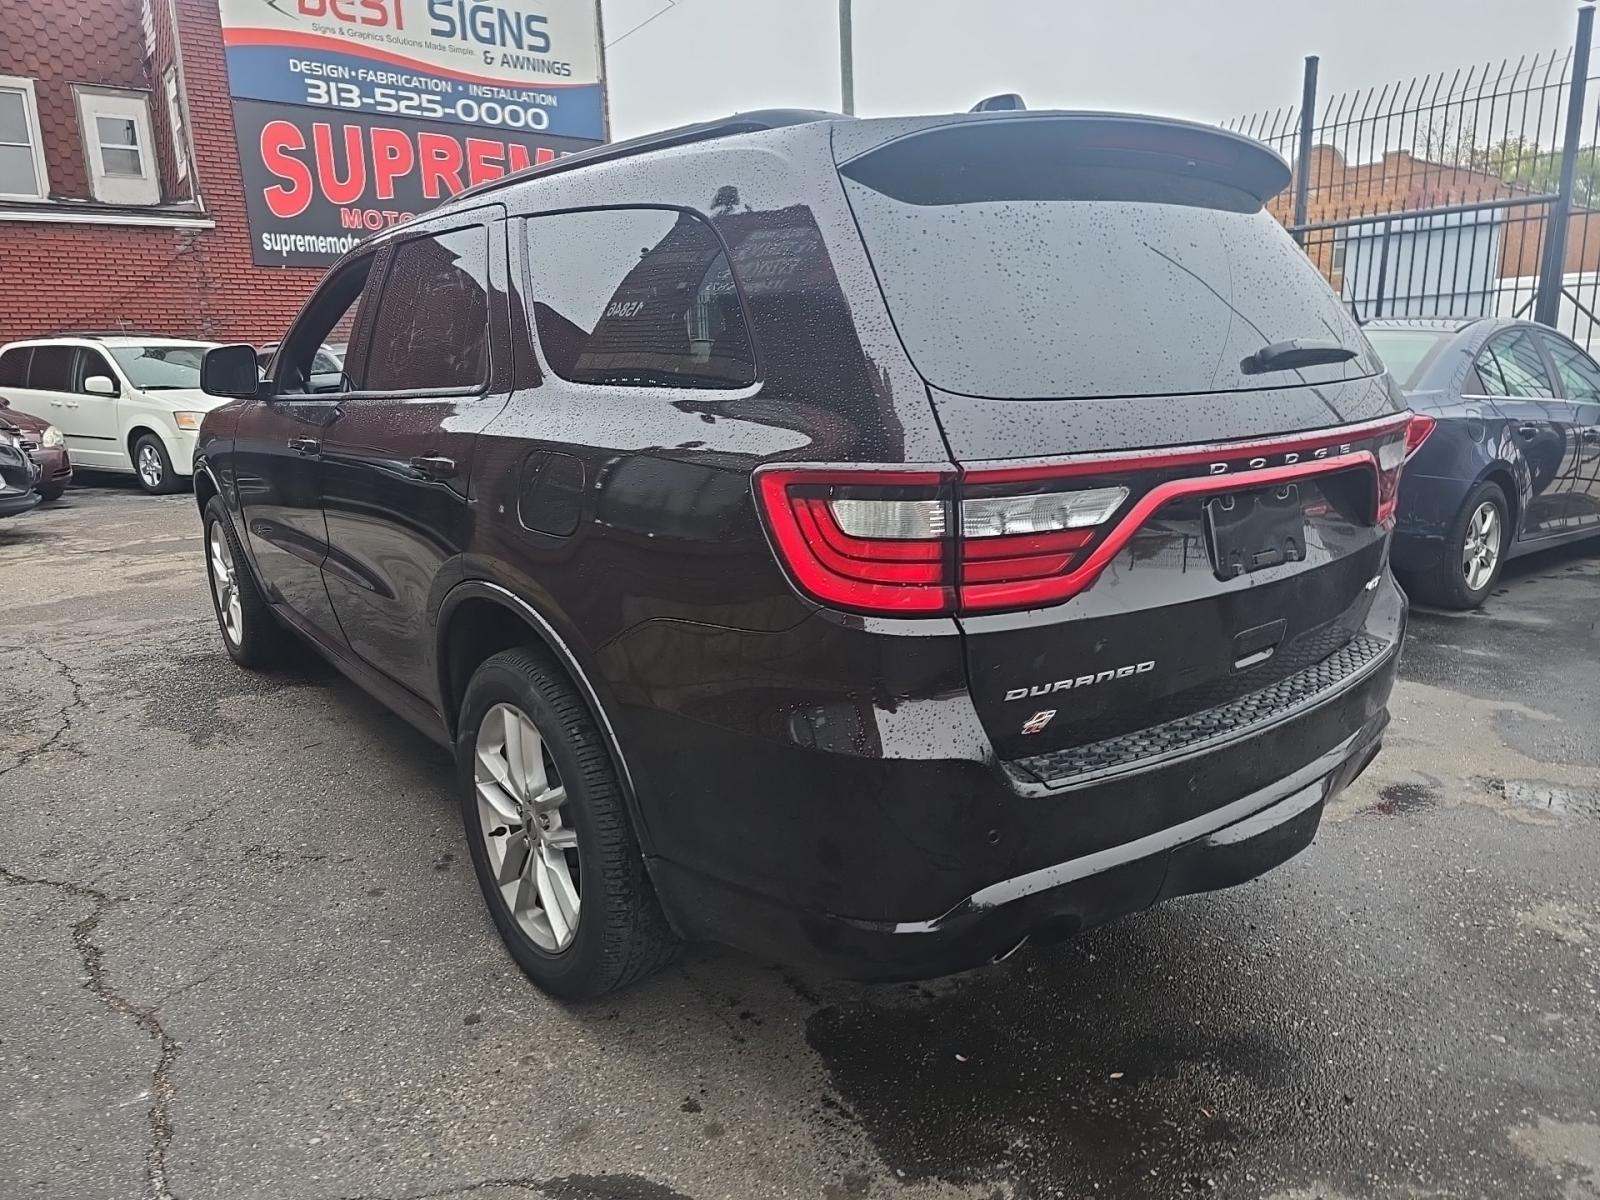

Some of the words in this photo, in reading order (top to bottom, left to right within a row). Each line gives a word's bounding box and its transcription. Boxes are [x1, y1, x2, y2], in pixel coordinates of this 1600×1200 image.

[311, 22, 337, 35] Signs
[339, 27, 345, 36] &
[347, 28, 384, 42] Graphics
[385, 34, 423, 49] Solutions
[424, 41, 446, 52] Made
[427, 0, 551, 54] SIGNS
[289, 58, 350, 80] DESIGN
[358, 68, 452, 94] FABRICATION
[469, 83, 558, 107] INSTALLATION
[483, 50, 494, 66] &
[500, 53, 572, 77] AWNINGS
[304, 77, 550, 131] 313-525-0000
[1209, 444, 1352, 476] DODGE
[1003, 660, 1156, 702] DURANGO
